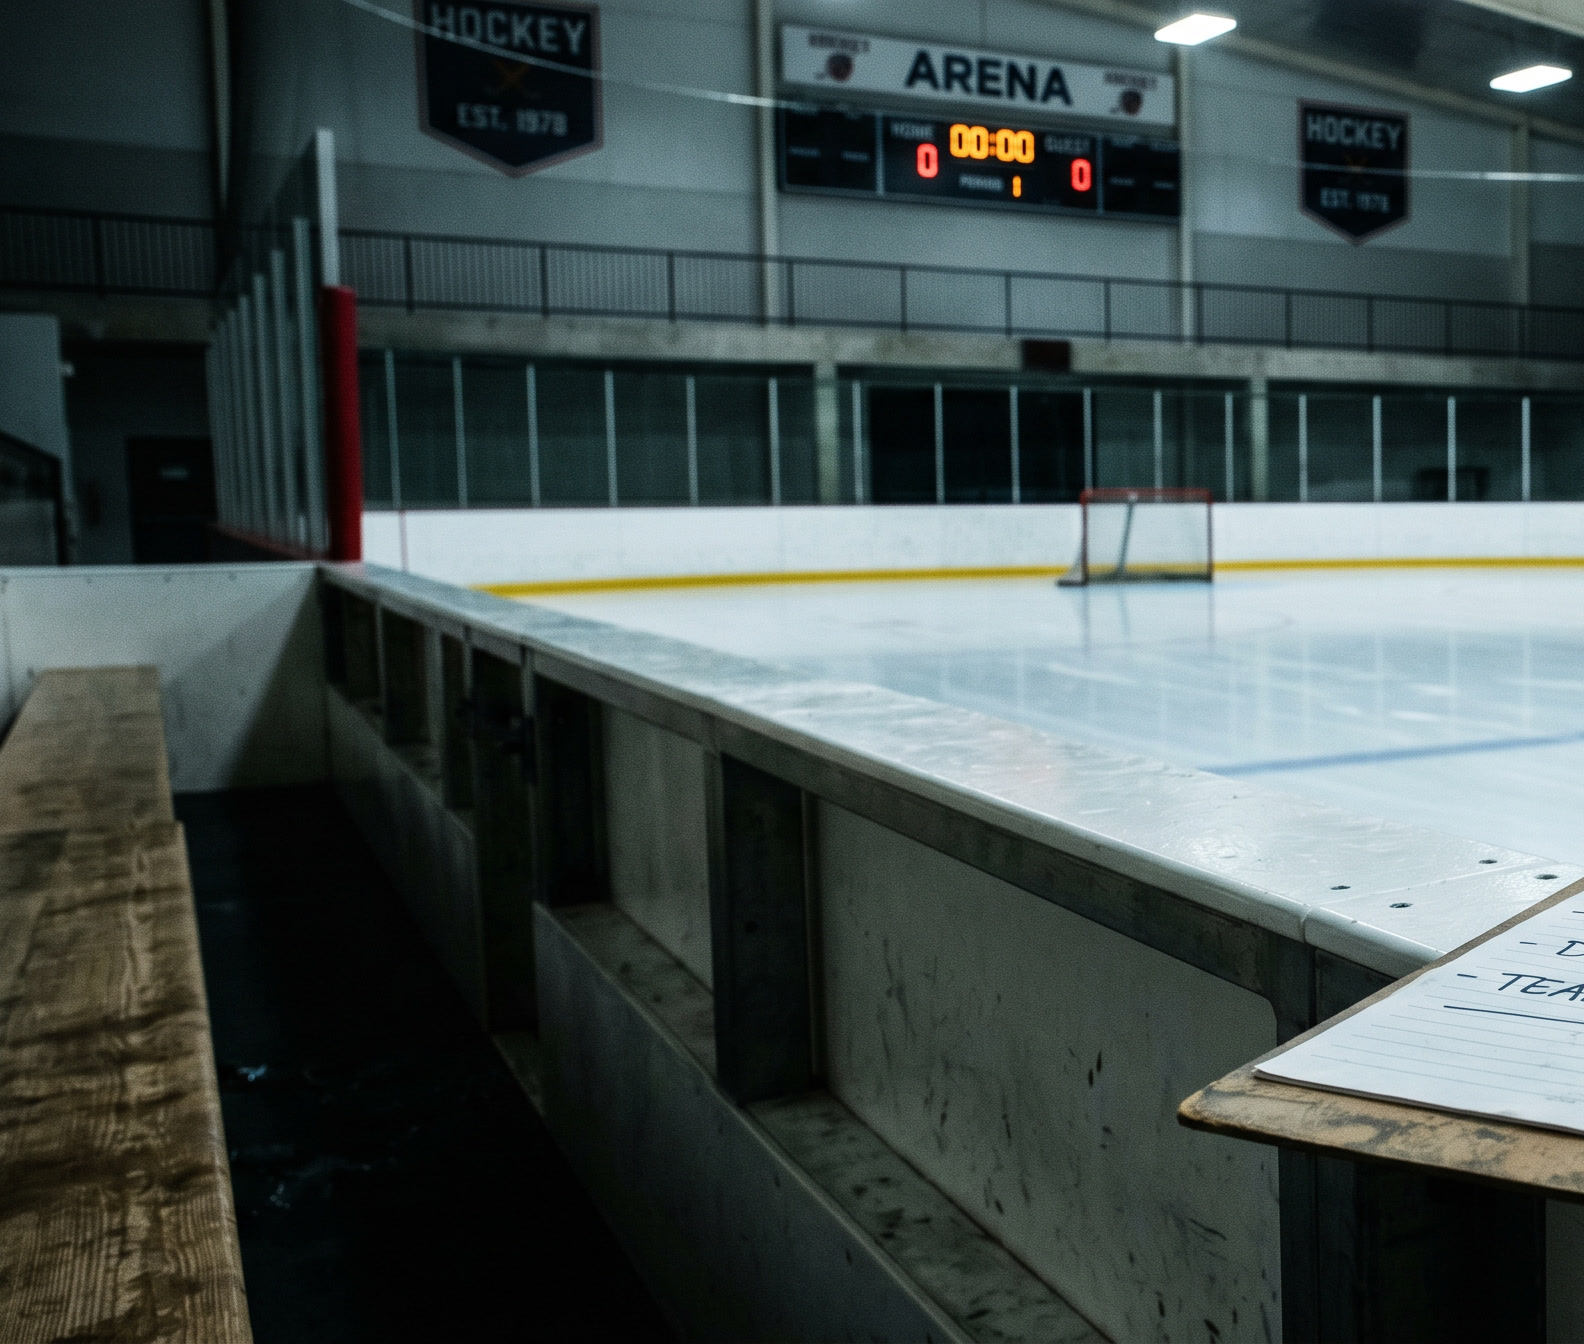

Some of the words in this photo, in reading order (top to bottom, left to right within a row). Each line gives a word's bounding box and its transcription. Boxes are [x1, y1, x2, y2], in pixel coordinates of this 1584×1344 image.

[430, 3, 587, 56] HOCKEY
[905, 50, 1074, 106] ARENA
[456, 103, 509, 132] EST.
[1306, 113, 1401, 151] HOCKEY
[916, 143, 939, 179] 0
[949, 123, 1035, 164] 00:00
[1012, 175, 1022, 198] 1
[1071, 158, 1092, 192] 0
